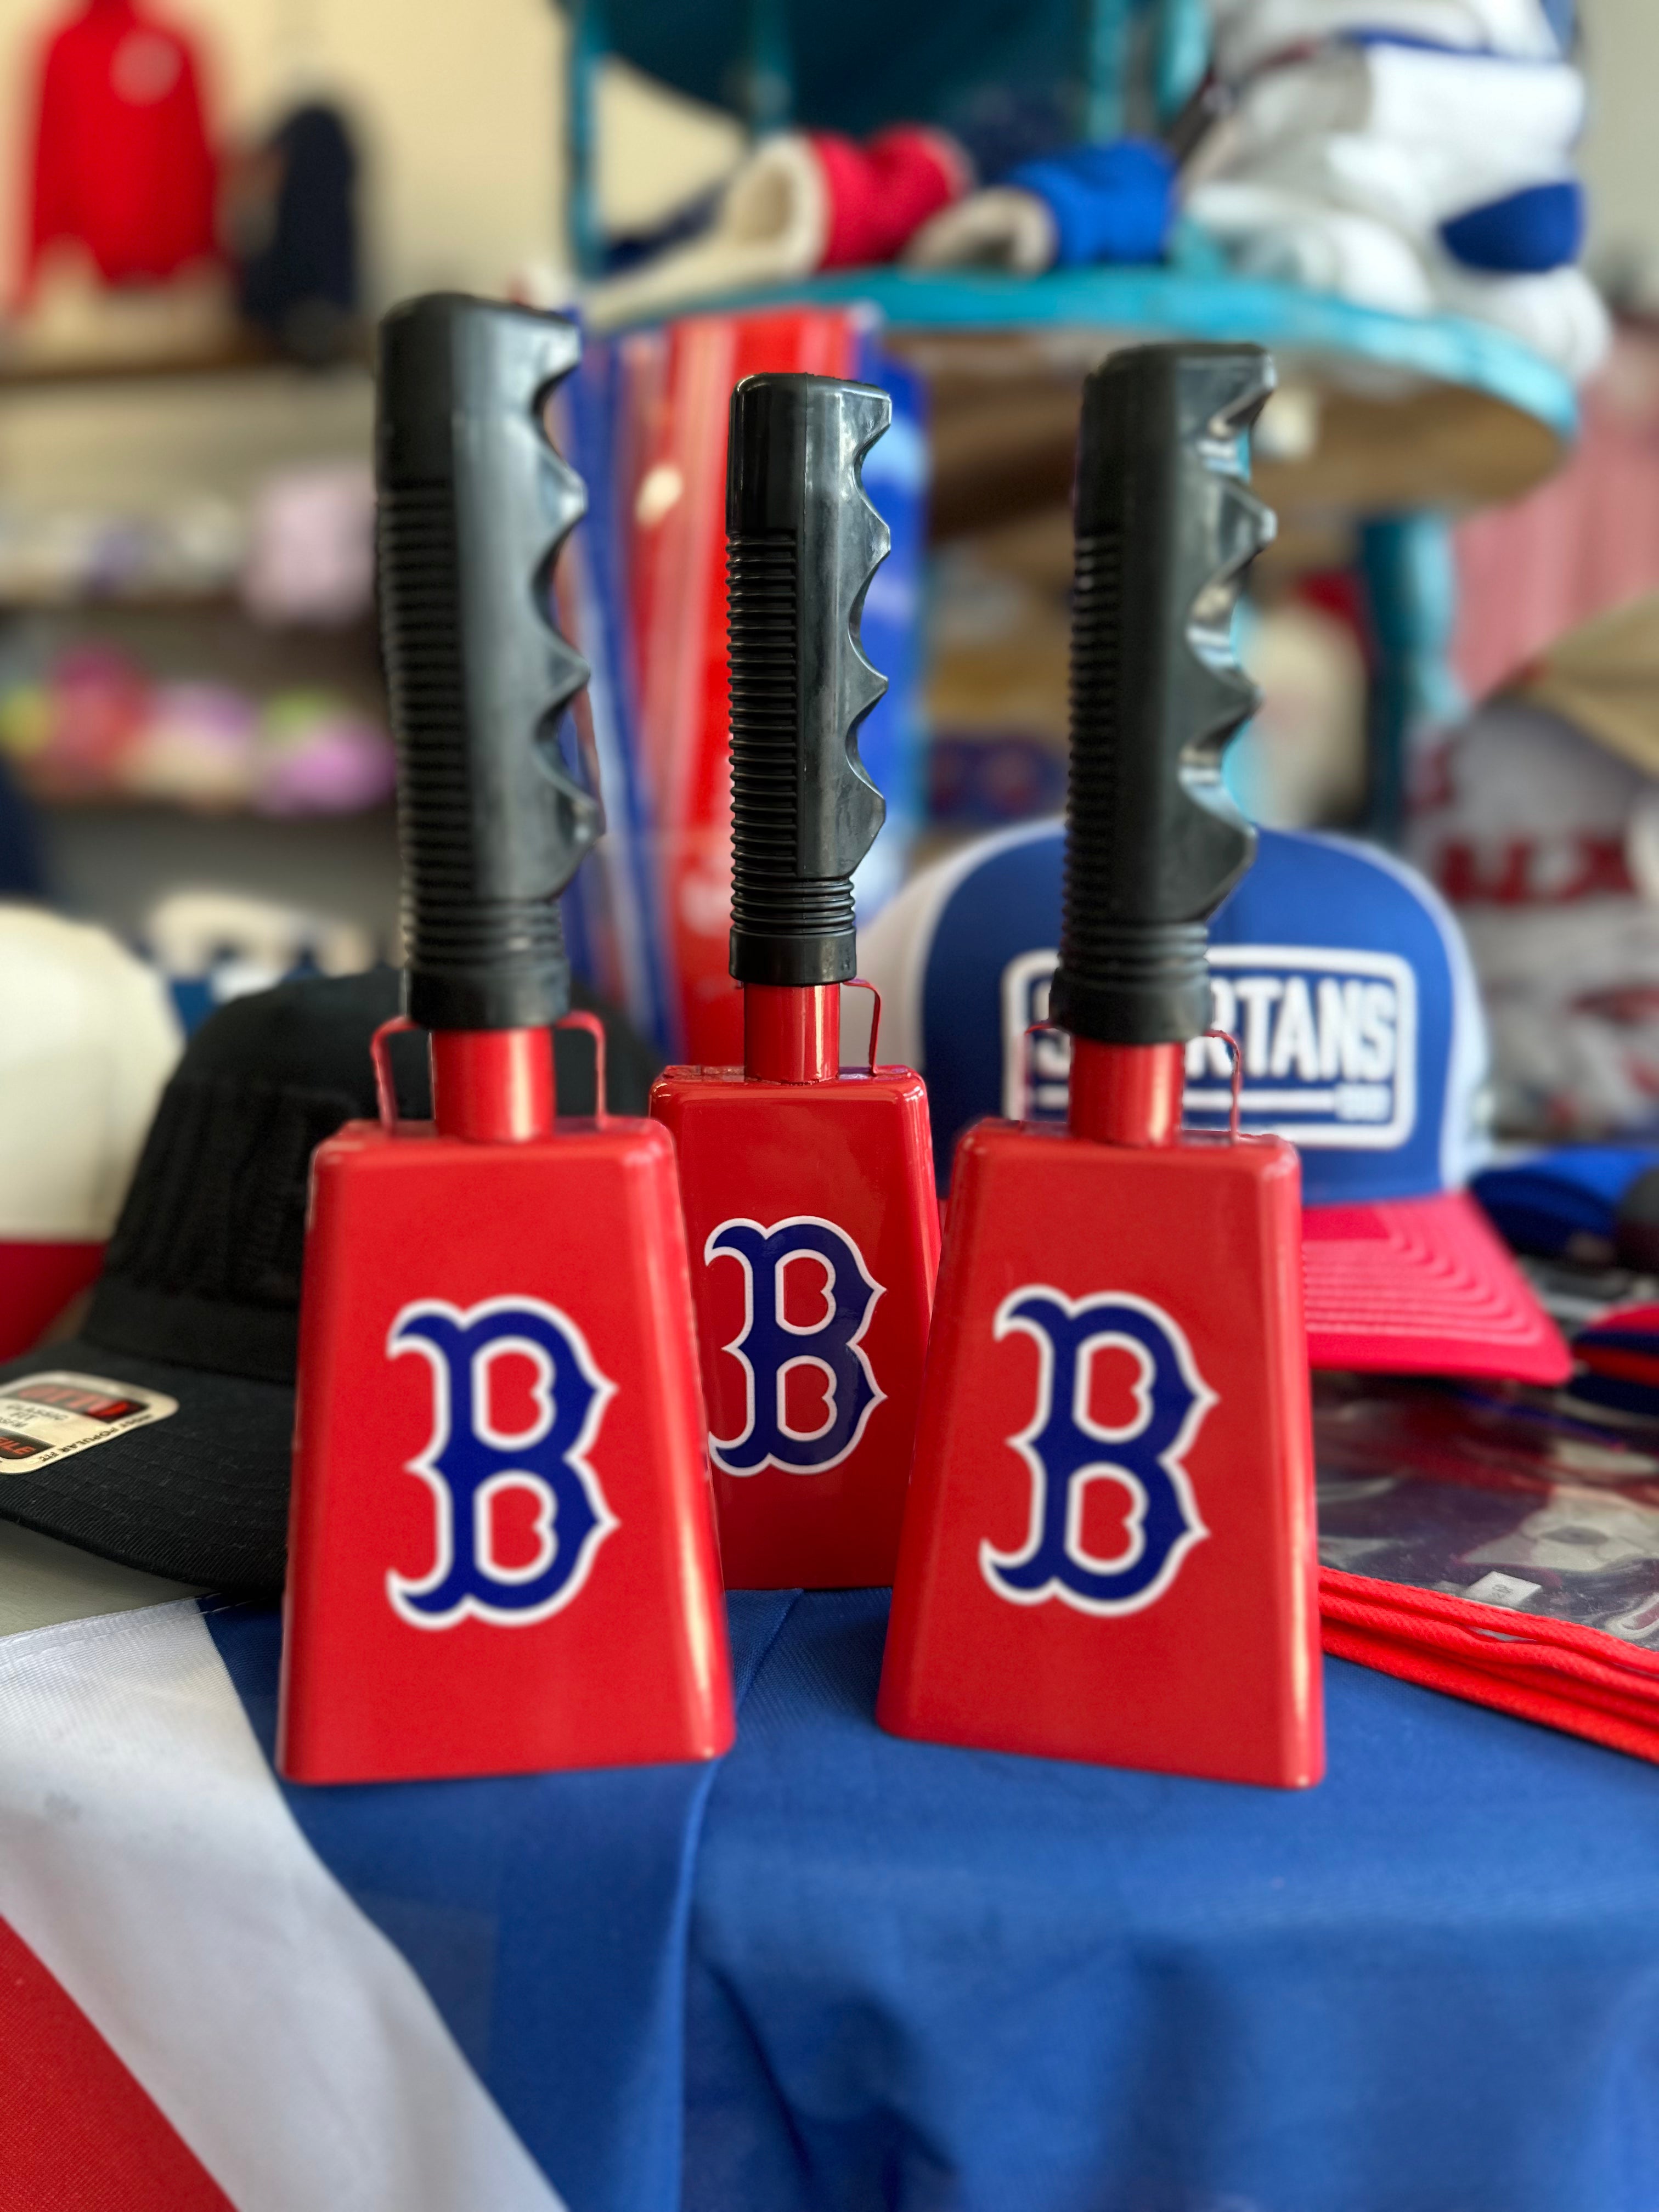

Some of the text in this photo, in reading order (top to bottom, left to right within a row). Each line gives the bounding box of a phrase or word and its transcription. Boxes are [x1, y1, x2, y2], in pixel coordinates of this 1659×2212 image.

[1032, 977, 1395, 1083] SRTANS
[58, 1426, 119, 1453] POPULAR
[386, 1293, 620, 1630] B
[704, 1215, 887, 1477] B
[979, 1284, 1219, 1617] B
